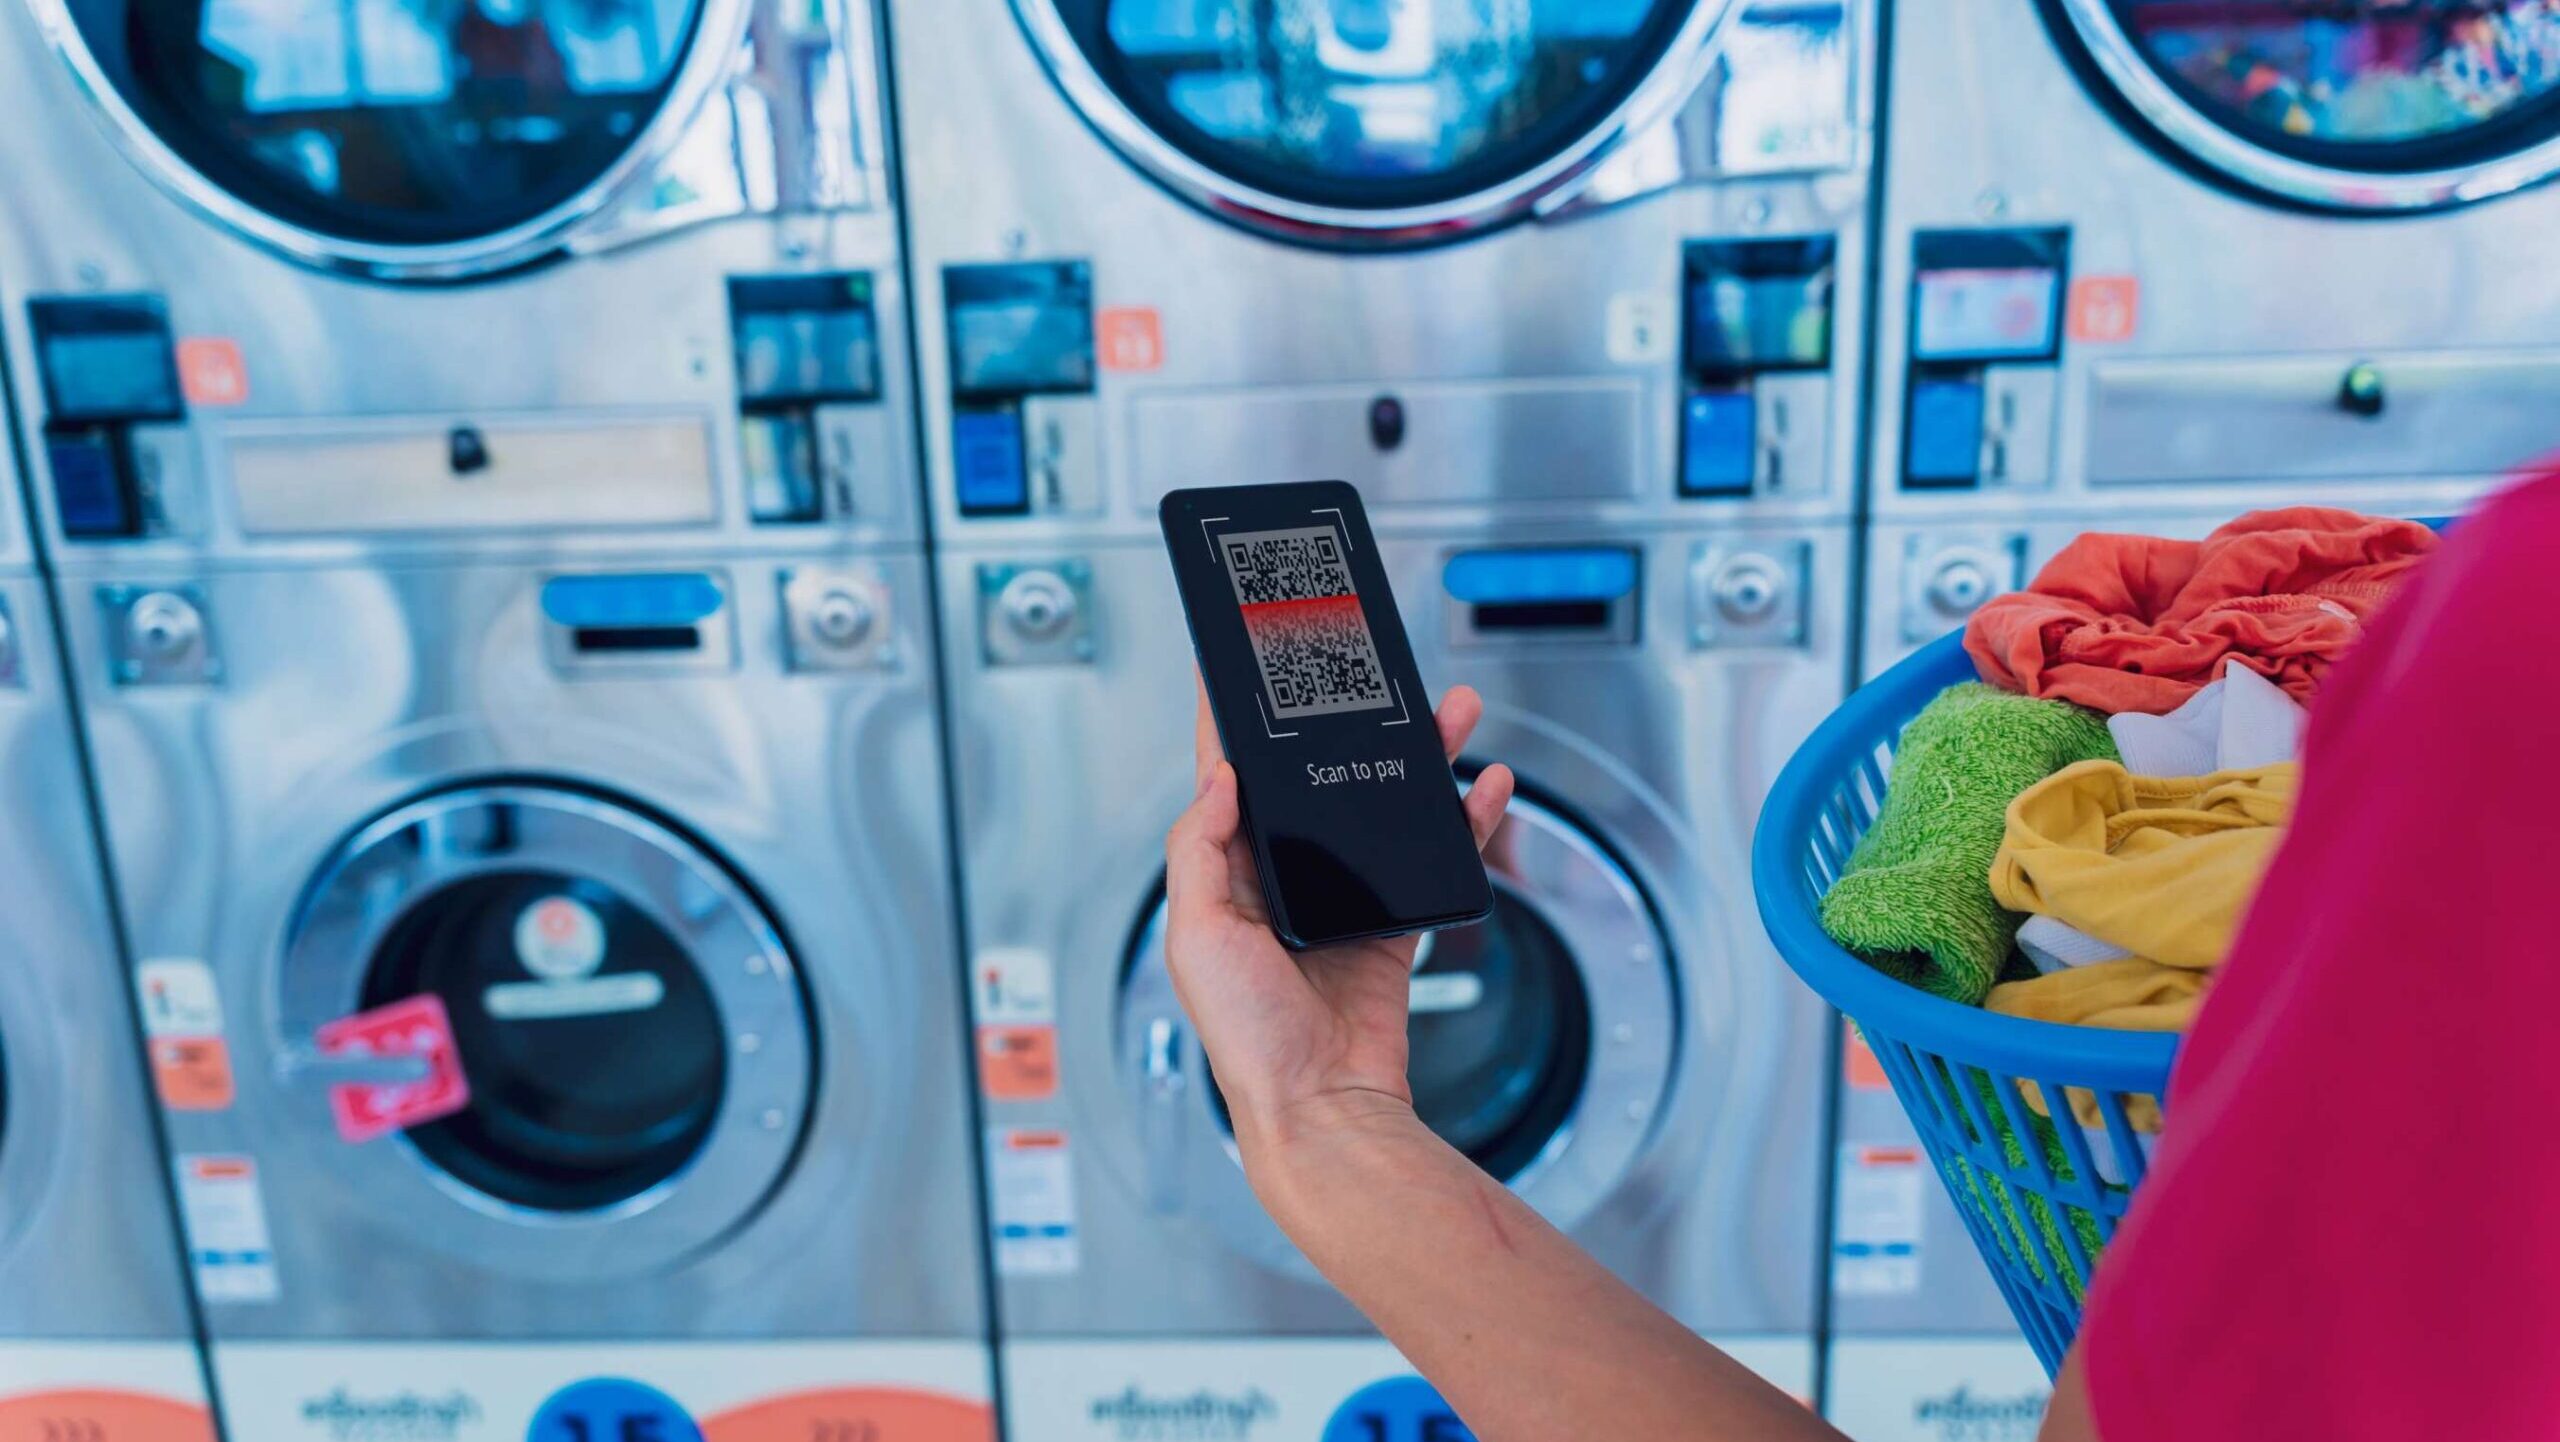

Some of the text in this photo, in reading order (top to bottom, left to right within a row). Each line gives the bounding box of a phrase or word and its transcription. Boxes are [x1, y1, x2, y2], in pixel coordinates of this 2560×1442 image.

[1307, 758, 1405, 785] Scan to pay
